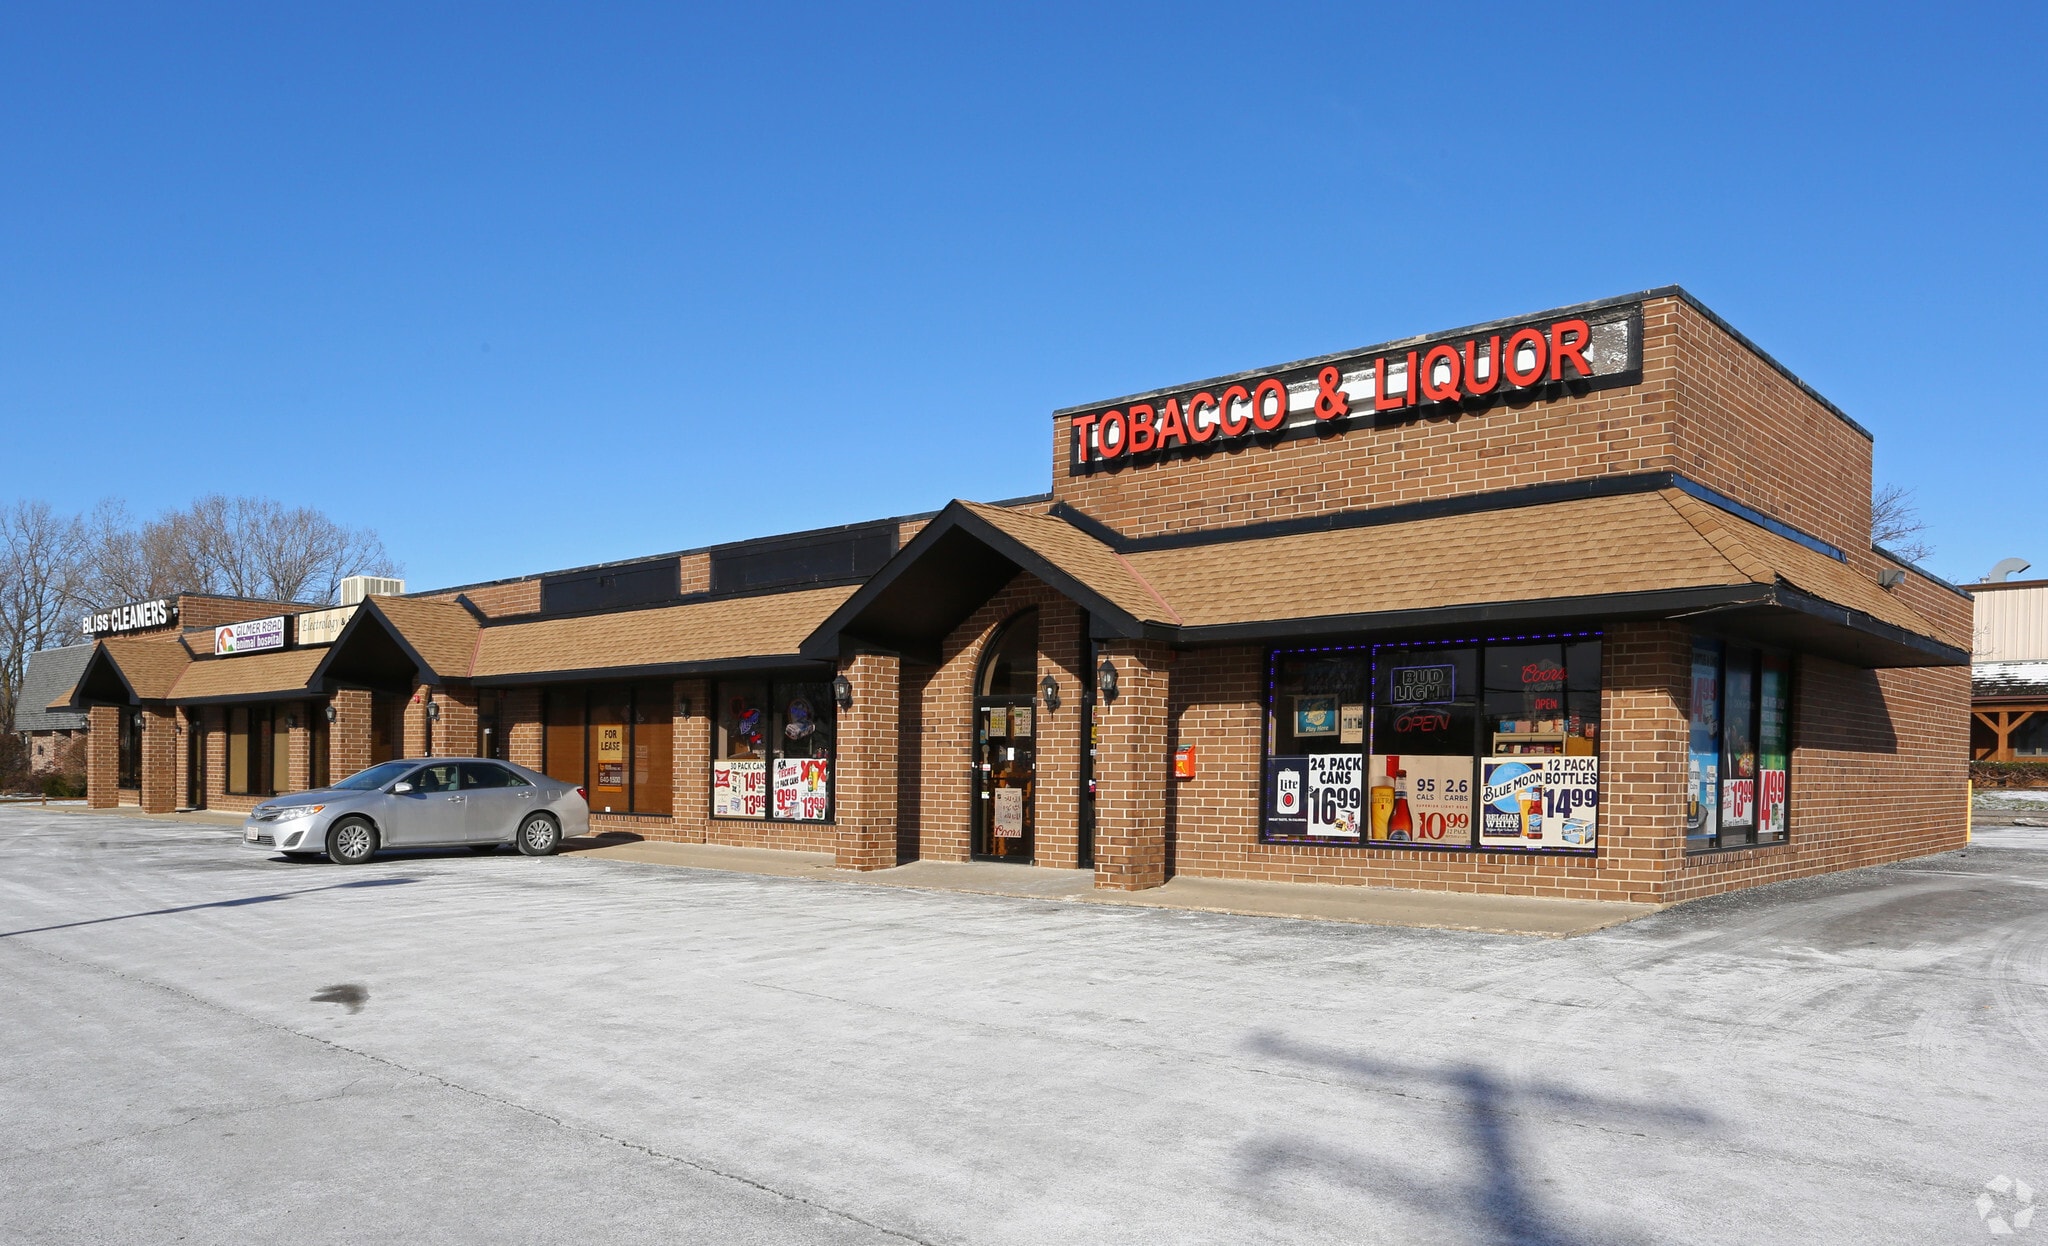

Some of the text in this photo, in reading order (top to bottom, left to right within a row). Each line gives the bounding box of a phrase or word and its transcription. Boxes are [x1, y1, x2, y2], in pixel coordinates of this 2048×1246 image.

[1072, 319, 1593, 462] TOBACCO & LIQUOR
[83, 599, 167, 634] BLISS CLEANERS
[302, 614, 340, 632] Electrology
[341, 618, 346, 626] &
[236, 619, 282, 636] GILMER ROAD
[236, 632, 282, 649] animal hospital
[1403, 669, 1443, 685] BUD
[1522, 663, 1568, 683] Coors
[1535, 698, 1558, 710] OPEN
[1395, 713, 1452, 733] OPEN
[604, 729, 617, 739] FOR
[601, 741, 620, 751] LEASE
[738, 762, 752, 770] PACK
[1310, 757, 1361, 771] 24 PACK
[1547, 758, 1595, 771] 12 PACK
[778, 766, 797, 779] TECATE
[1319, 771, 1352, 784] CANS
[1545, 773, 1597, 785] BOTTLES
[1280, 779, 1298, 792] Lite
[1417, 779, 1435, 792] 95
[1445, 779, 1468, 793] 2.6
[1483, 772, 1543, 802] BLUE MOON
[1486, 813, 1520, 821] BELGIAN
[1486, 820, 1519, 828] WHITE
